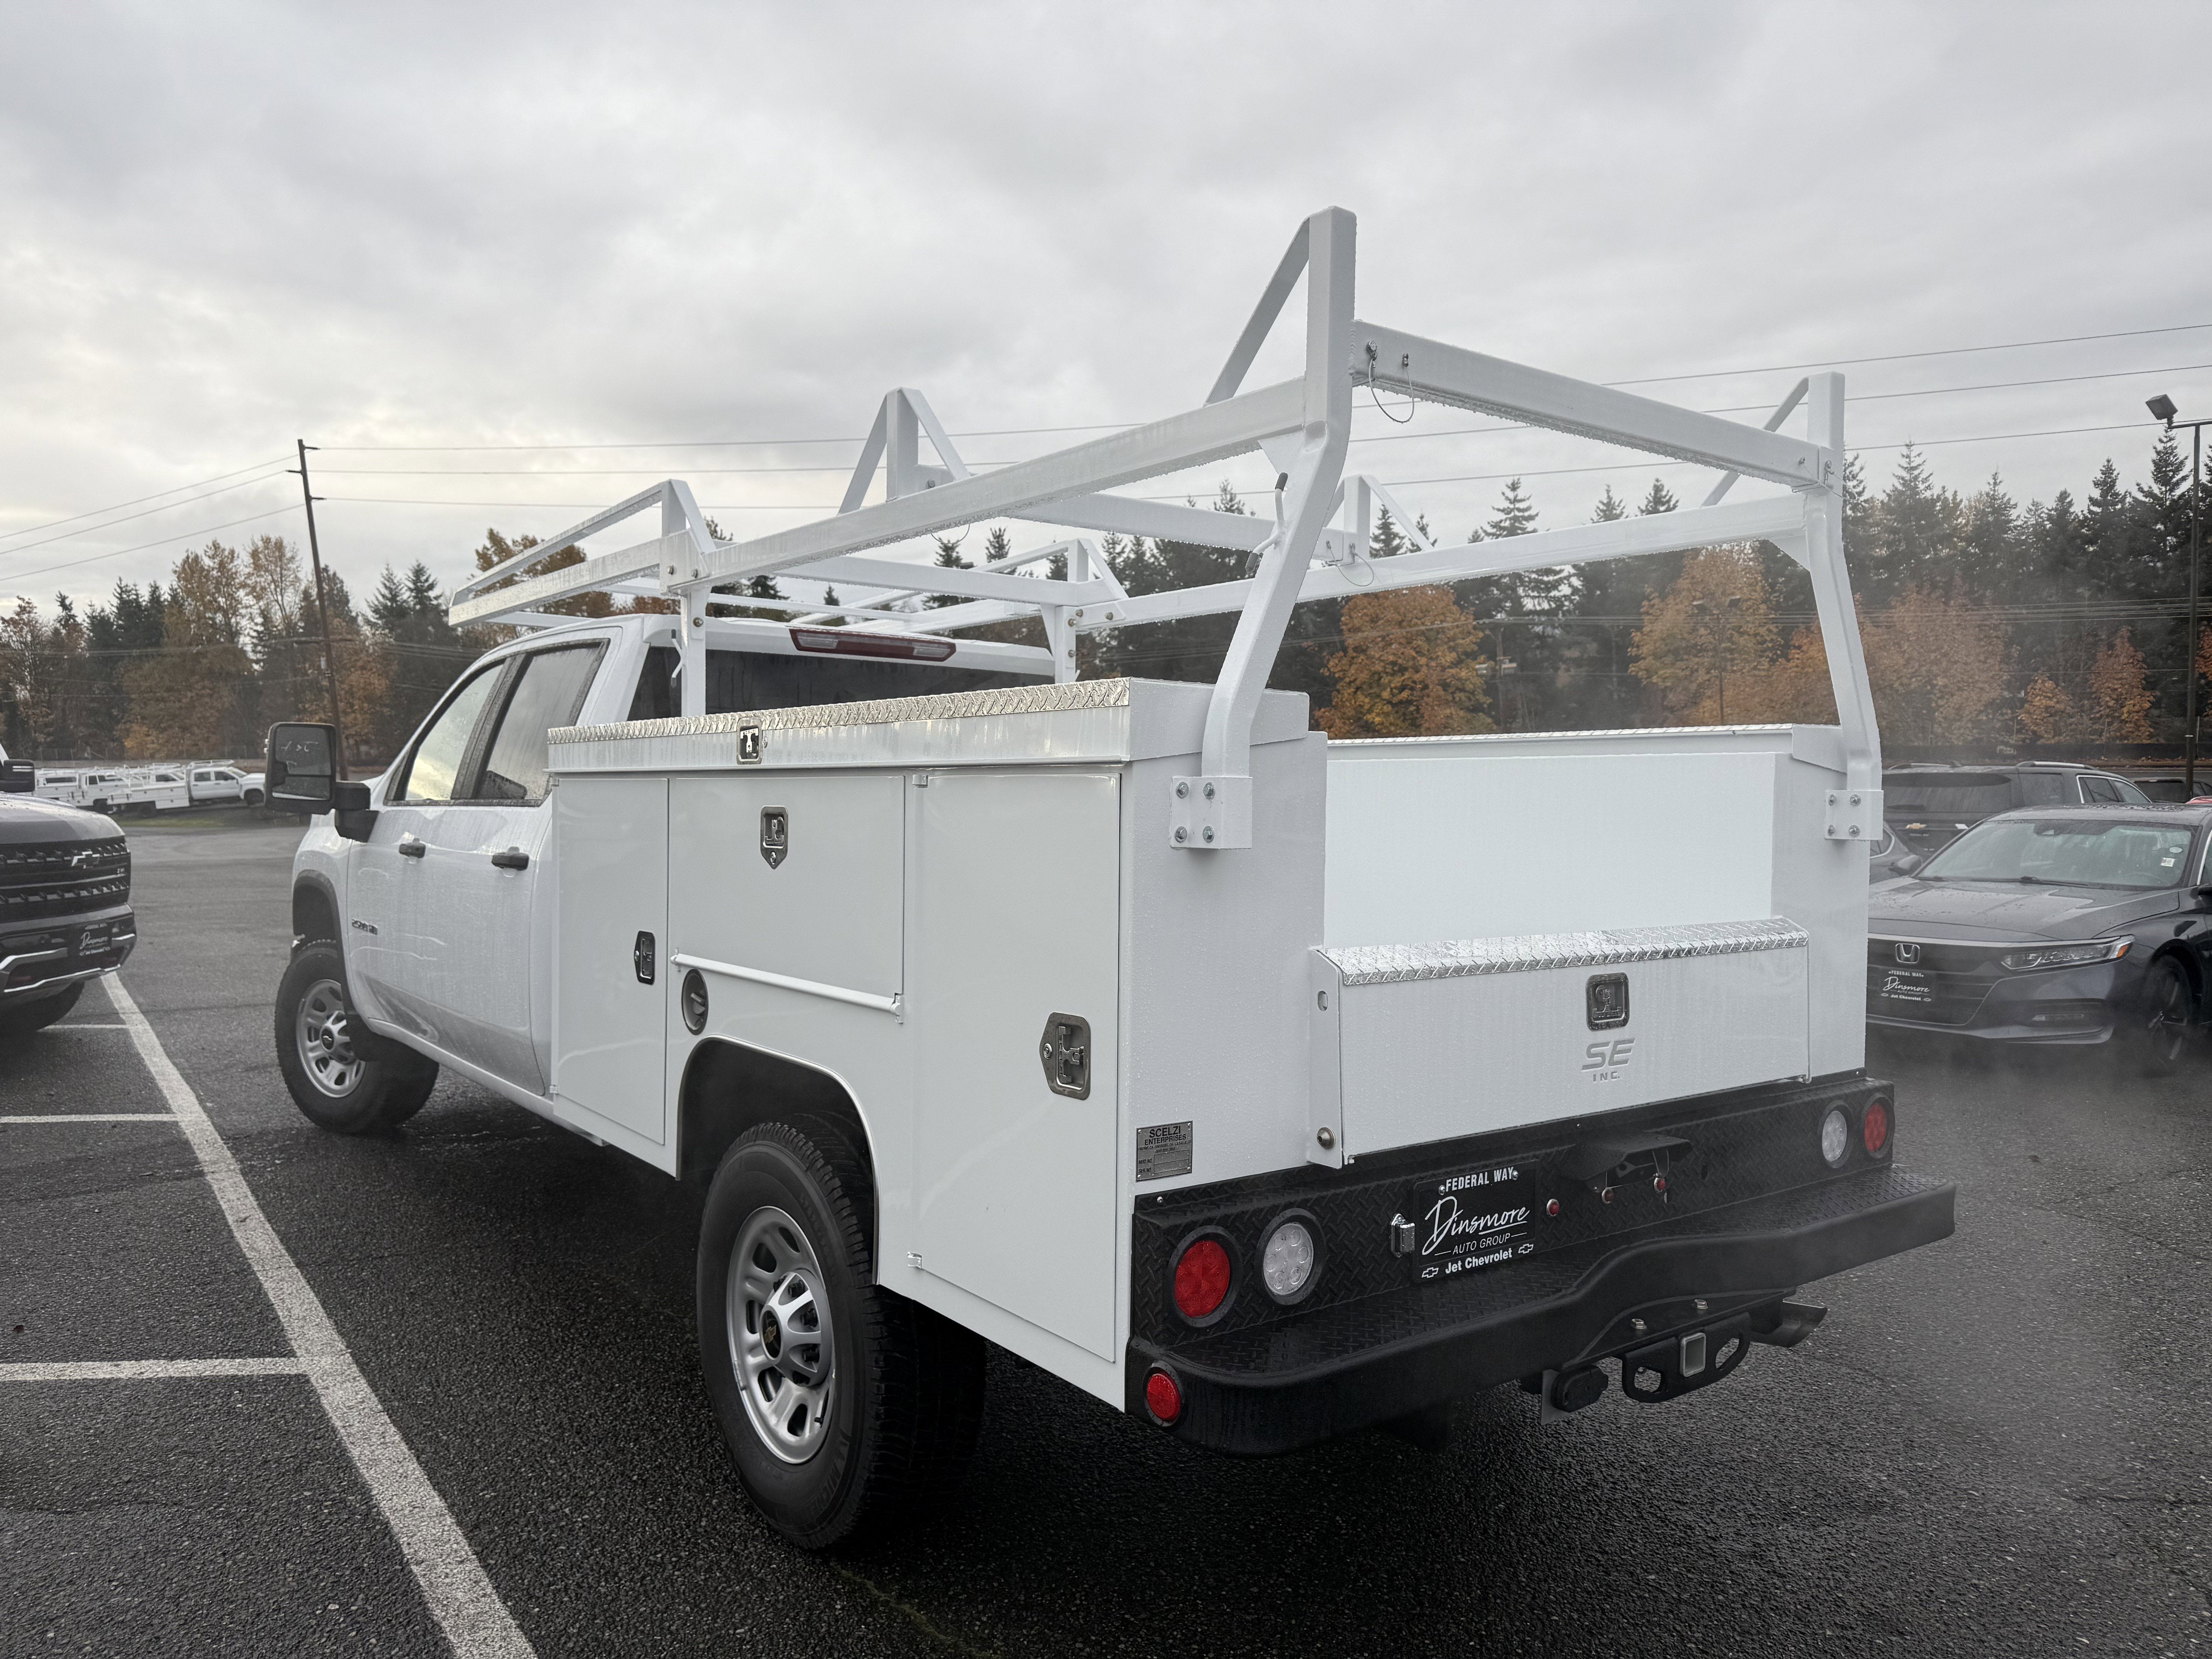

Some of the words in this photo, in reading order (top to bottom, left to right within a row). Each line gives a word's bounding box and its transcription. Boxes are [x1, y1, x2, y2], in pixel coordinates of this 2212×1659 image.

[1581, 1037, 1635, 1070] SE
[1593, 1071, 1620, 1082] INC.
[1145, 1134, 1186, 1145] ENTERPRISES
[1149, 1125, 1181, 1138] SCELZI
[1446, 1172, 1489, 1192] FEDERAL
[1494, 1166, 1514, 1182] WAY
[1422, 1196, 1530, 1255] Dinsmore
[1453, 1241, 1477, 1255] AUTO
[1480, 1233, 1510, 1248] GROUP
[1445, 1260, 1462, 1274] Jet
[1465, 1248, 1512, 1269] Chevrolet
